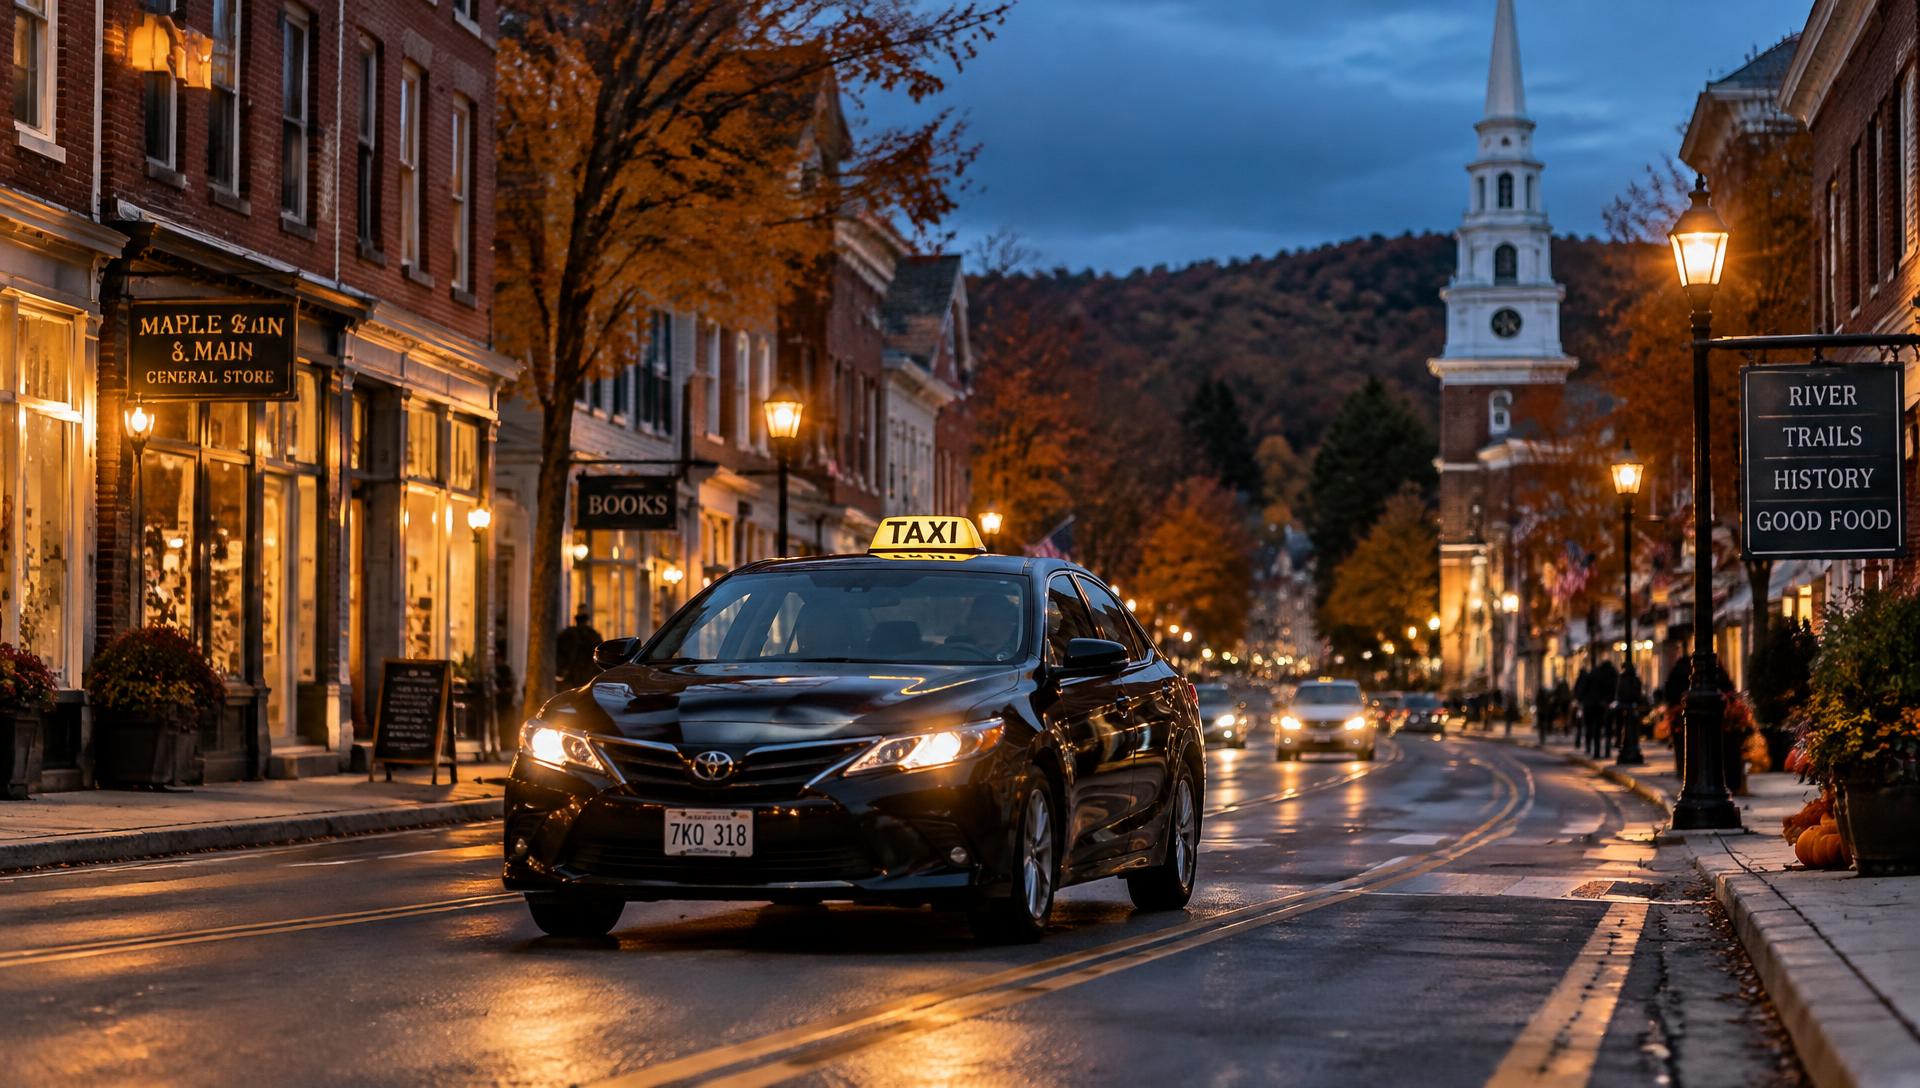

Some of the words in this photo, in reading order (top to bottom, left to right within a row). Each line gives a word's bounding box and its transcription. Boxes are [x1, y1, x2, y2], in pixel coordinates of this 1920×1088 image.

[140, 314, 222, 336] MAPLE
[194, 341, 253, 361] MAIN
[146, 370, 218, 384] GENERAL
[223, 370, 274, 384] STORE
[1789, 385, 1858, 406] RIVER
[1783, 425, 1863, 447] TRAILS
[1774, 468, 1875, 490] HISTORY
[588, 495, 668, 515] BOOKS
[1756, 511, 1822, 531] GOOD
[1829, 510, 1892, 530] FOOD
[886, 521, 958, 545] TAXI
[713, 824, 747, 846] 318
